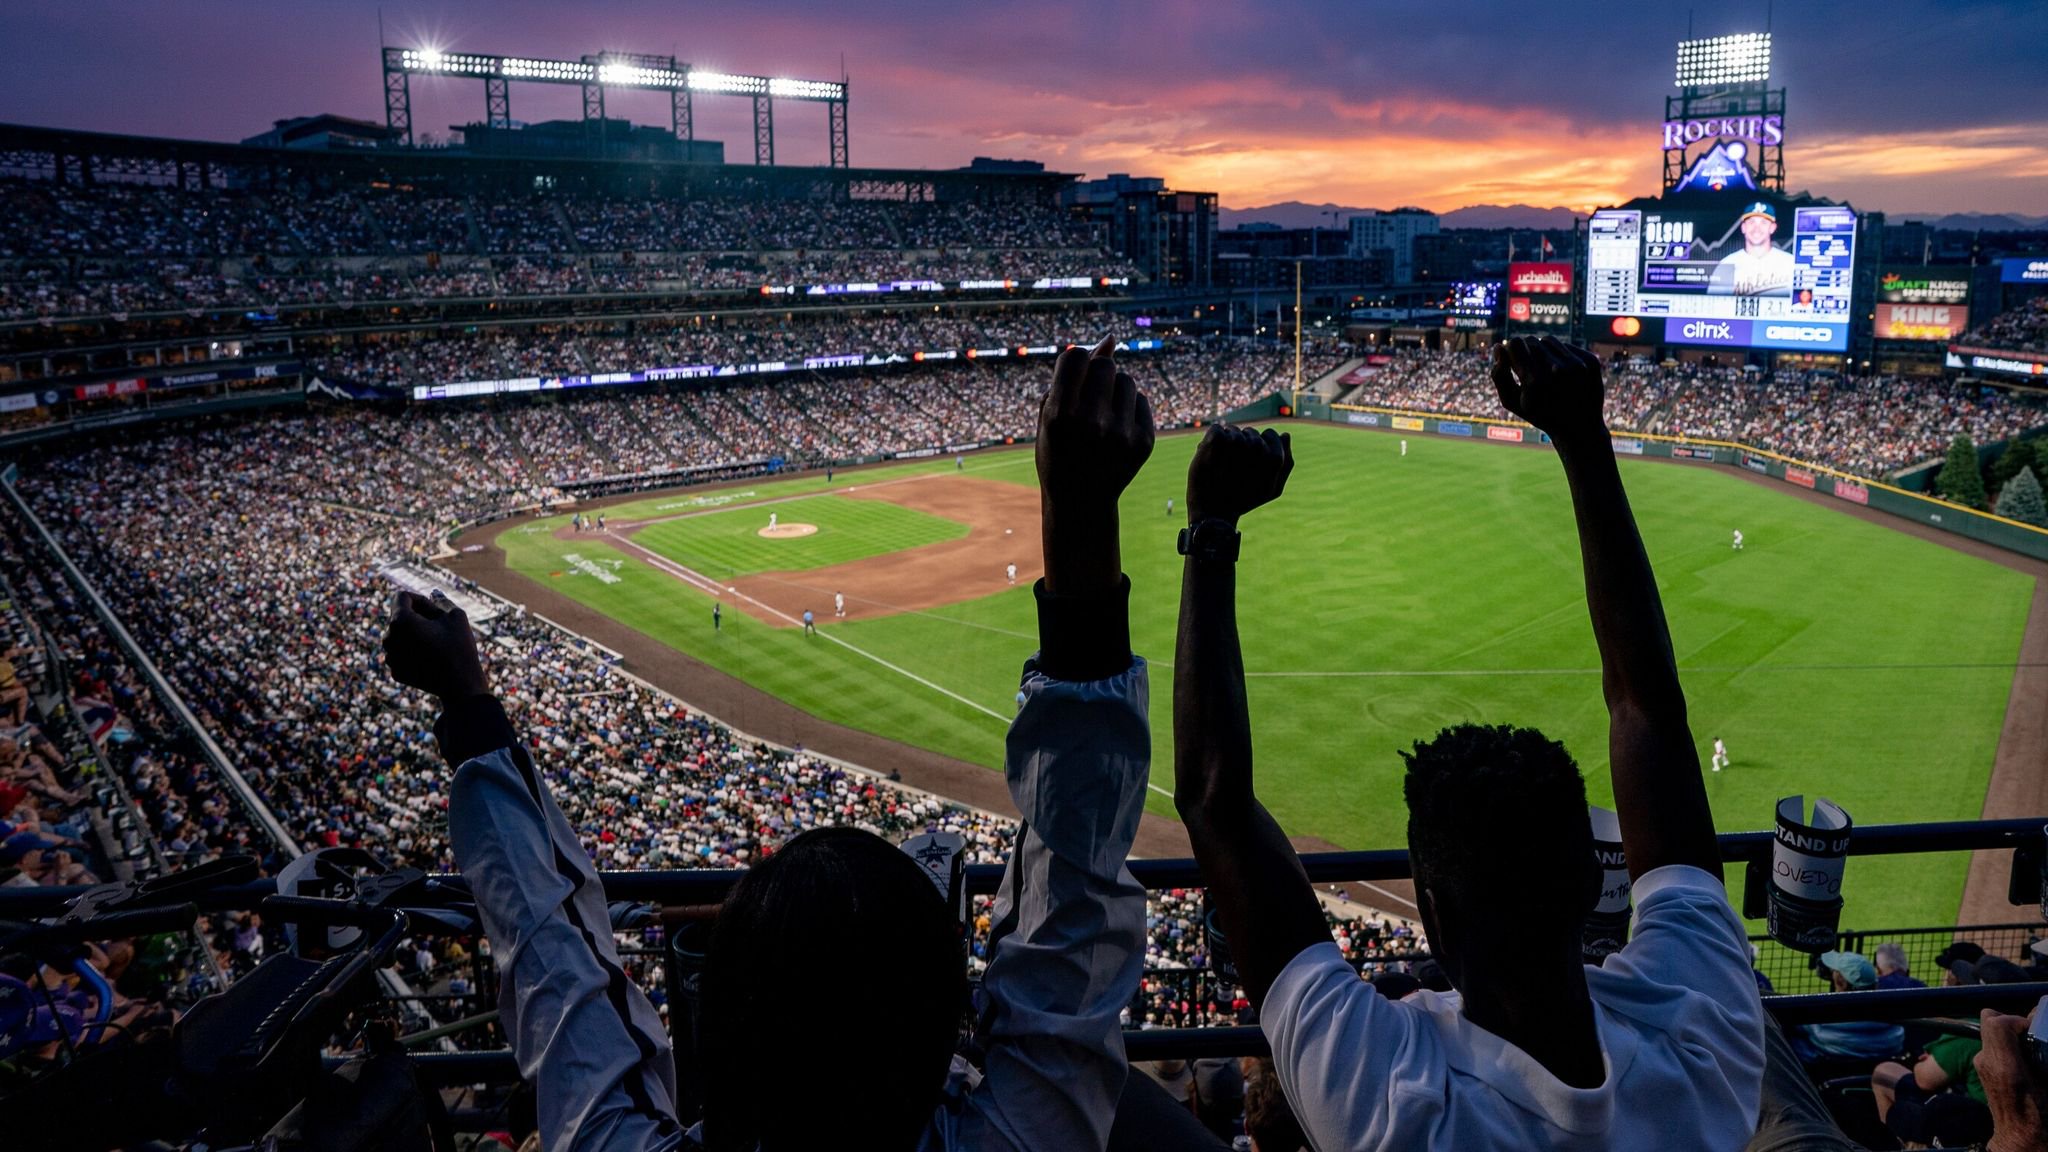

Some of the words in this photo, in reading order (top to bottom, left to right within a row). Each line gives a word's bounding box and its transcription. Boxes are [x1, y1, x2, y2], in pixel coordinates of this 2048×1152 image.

[1661, 115, 1783, 150] ROCKIES
[1646, 222, 1694, 243] OLSON
[1517, 271, 1564, 283] uchealth
[1530, 304, 1569, 315] TOYOTA
[1891, 306, 1950, 325] KING
[1454, 318, 1487, 328] TUNDRA
[1683, 321, 1730, 340] citrix
[1765, 325, 1832, 342] GEICO
[255, 365, 279, 378] FOX
[1348, 414, 1377, 425] GEICO
